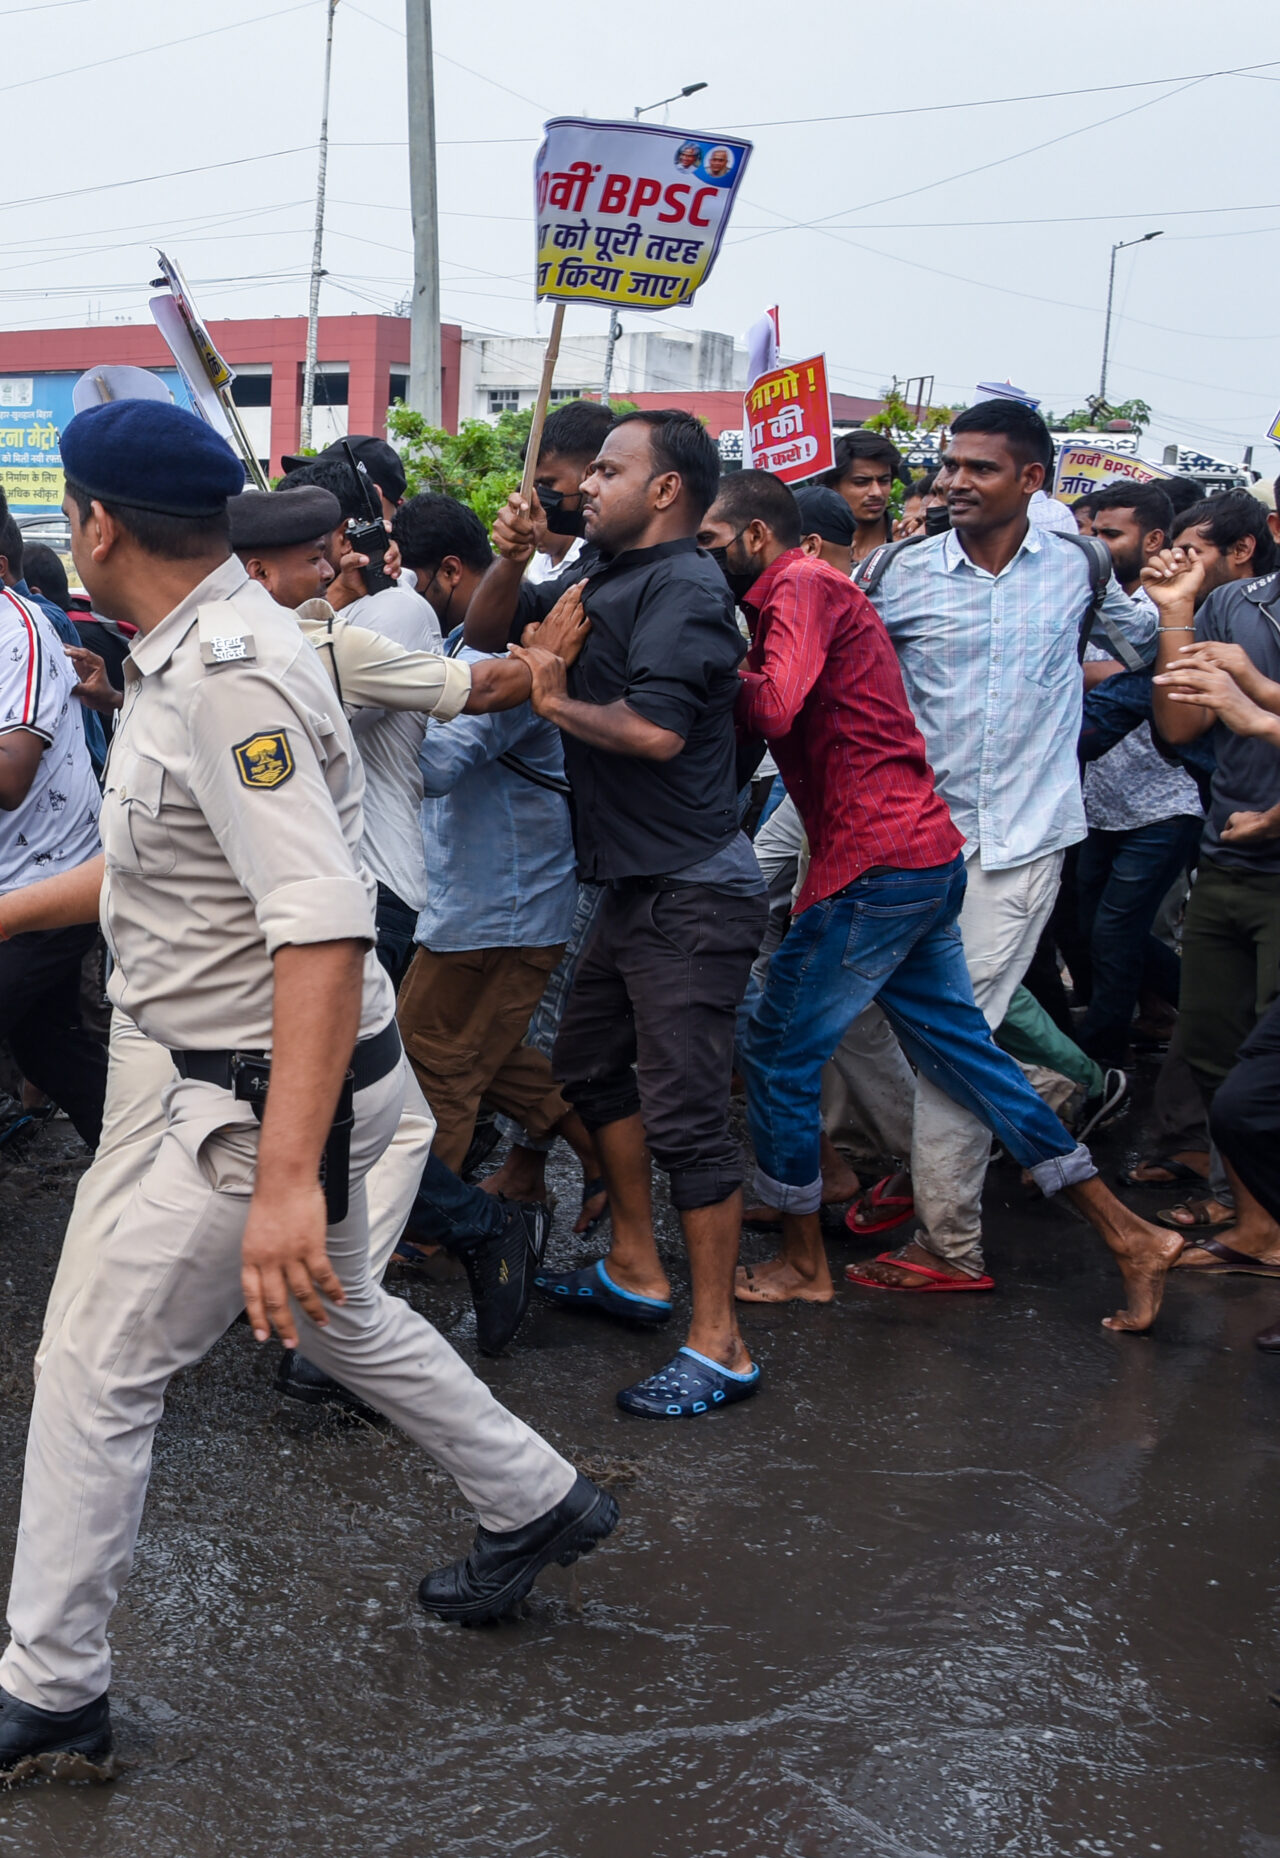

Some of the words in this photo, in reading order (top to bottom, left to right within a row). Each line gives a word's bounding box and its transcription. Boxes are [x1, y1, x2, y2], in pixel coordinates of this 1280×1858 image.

[598, 174, 719, 227] BPSC
[553, 218, 591, 251] को
[595, 223, 643, 262] पूरी
[645, 234, 704, 265] तरह
[556, 257, 624, 292] किया
[26, 422, 55, 451] मेट्रो
[767, 404, 805, 438] की
